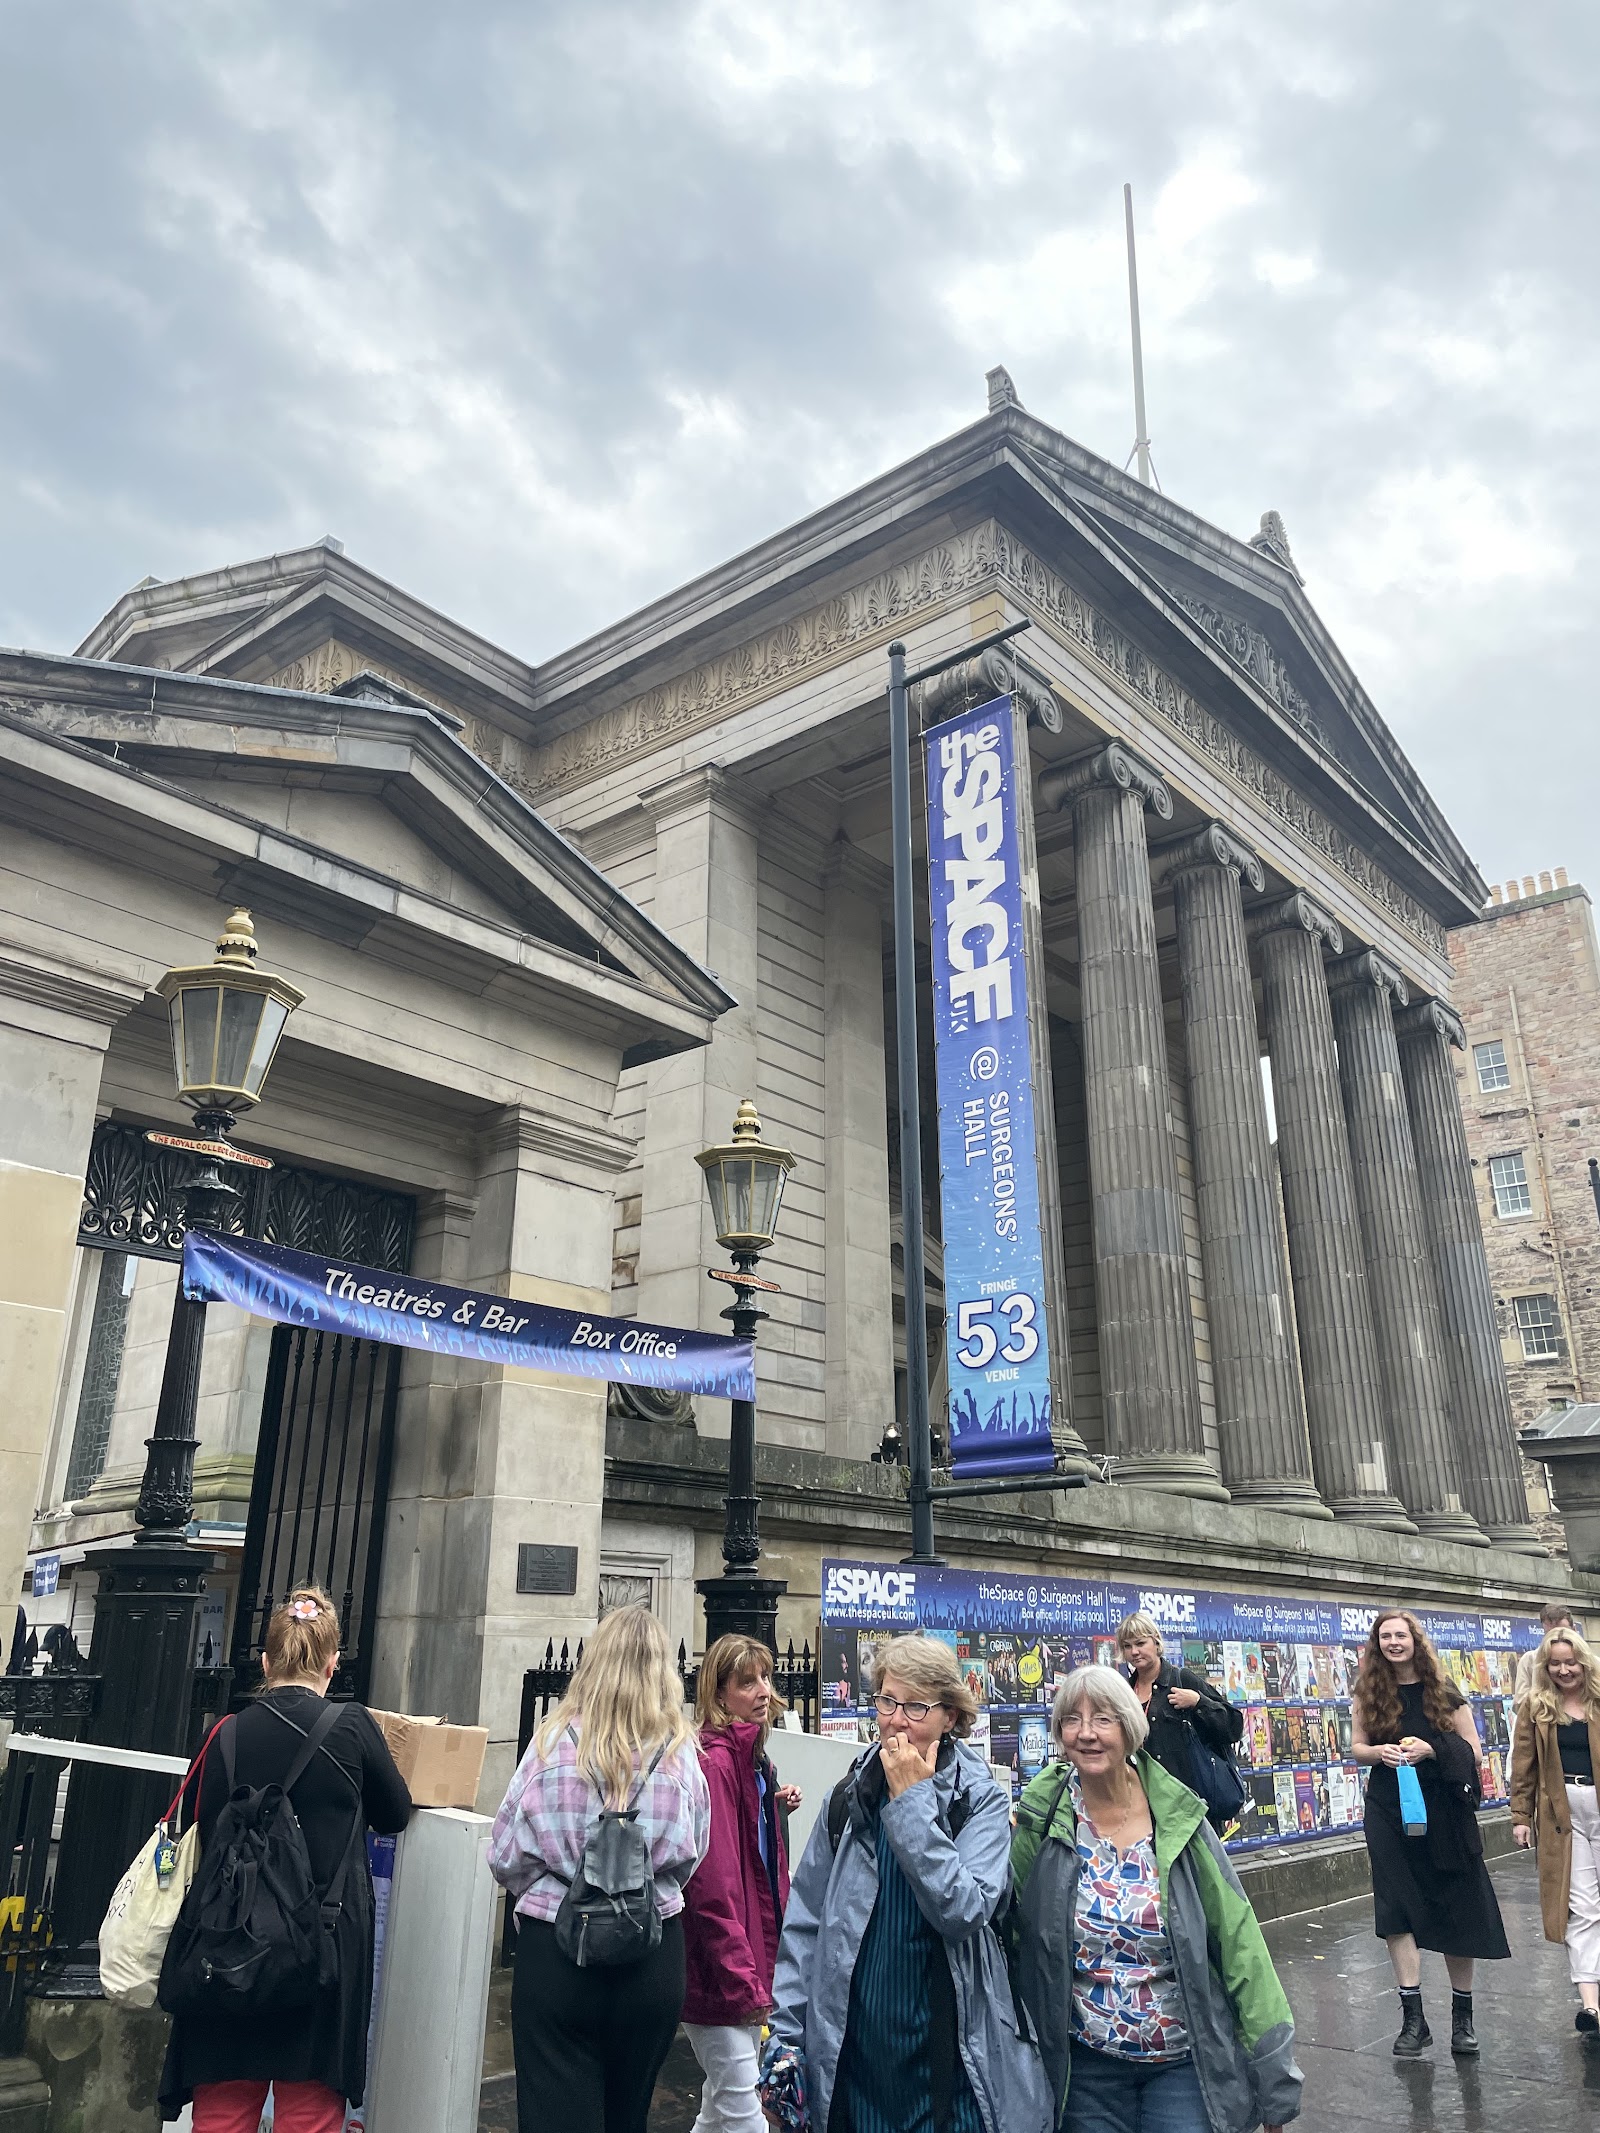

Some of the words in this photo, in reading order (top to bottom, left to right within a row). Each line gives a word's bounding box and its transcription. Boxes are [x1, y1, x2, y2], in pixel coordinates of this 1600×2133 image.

[941, 724, 1000, 769] the
[942, 751, 1013, 1023] SPACE
[969, 1046, 1000, 1080] @
[153, 1134, 168, 1144] THE
[170, 1138, 195, 1149] ROYAL
[962, 1099, 986, 1167] HALL
[987, 1091, 1018, 1242] SURGEONS'
[980, 1278, 1018, 1296] FRINGE
[325, 1267, 446, 1319] Theatres
[452, 1300, 477, 1325] &
[480, 1304, 530, 1335] Bar
[956, 1291, 1040, 1370] 53
[570, 1321, 615, 1350] Box
[619, 1330, 678, 1360] Office
[984, 1368, 1020, 1383] VENUE
[825, 1567, 837, 1603] the
[836, 1568, 916, 1607] SPACE
[979, 1583, 1024, 1605] theSpace
[1027, 1586, 1038, 1607] @
[1041, 1587, 1084, 1608] Surgeons'
[1086, 1590, 1103, 1607] Hall
[1109, 1593, 1127, 1605] Venue
[203, 1605, 223, 1614] BAR
[825, 1607, 916, 1622] www.thespaceuk.com
[1021, 1608, 1034, 1620] Box
[1036, 1608, 1054, 1620] office:
[1055, 1610, 1072, 1621] 0131
[1074, 1611, 1087, 1622] 226
[1088, 1612, 1104, 1623] 0000
[1144, 1592, 1196, 1622] SPACE
[1233, 1603, 1264, 1620] theSpace
[1264, 1605, 1274, 1622] @
[1273, 1606, 1303, 1622] Surgeons'
[1304, 1608, 1317, 1621] Hall
[1319, 1610, 1332, 1619] Venue
[1111, 1609, 1121, 1623] 53
[857, 1630, 869, 1642] Eva
[869, 1630, 893, 1642] Cassidy
[1262, 1623, 1272, 1632] Box
[1321, 1623, 1331, 1635] 53
[1486, 1619, 1511, 1639] SPACE
[1468, 1632, 1476, 1642] 53
[957, 1645, 970, 1658] SEX
[821, 1722, 857, 1732] SHAKESPEARE'S
[1020, 1735, 1047, 1752] Matilda
